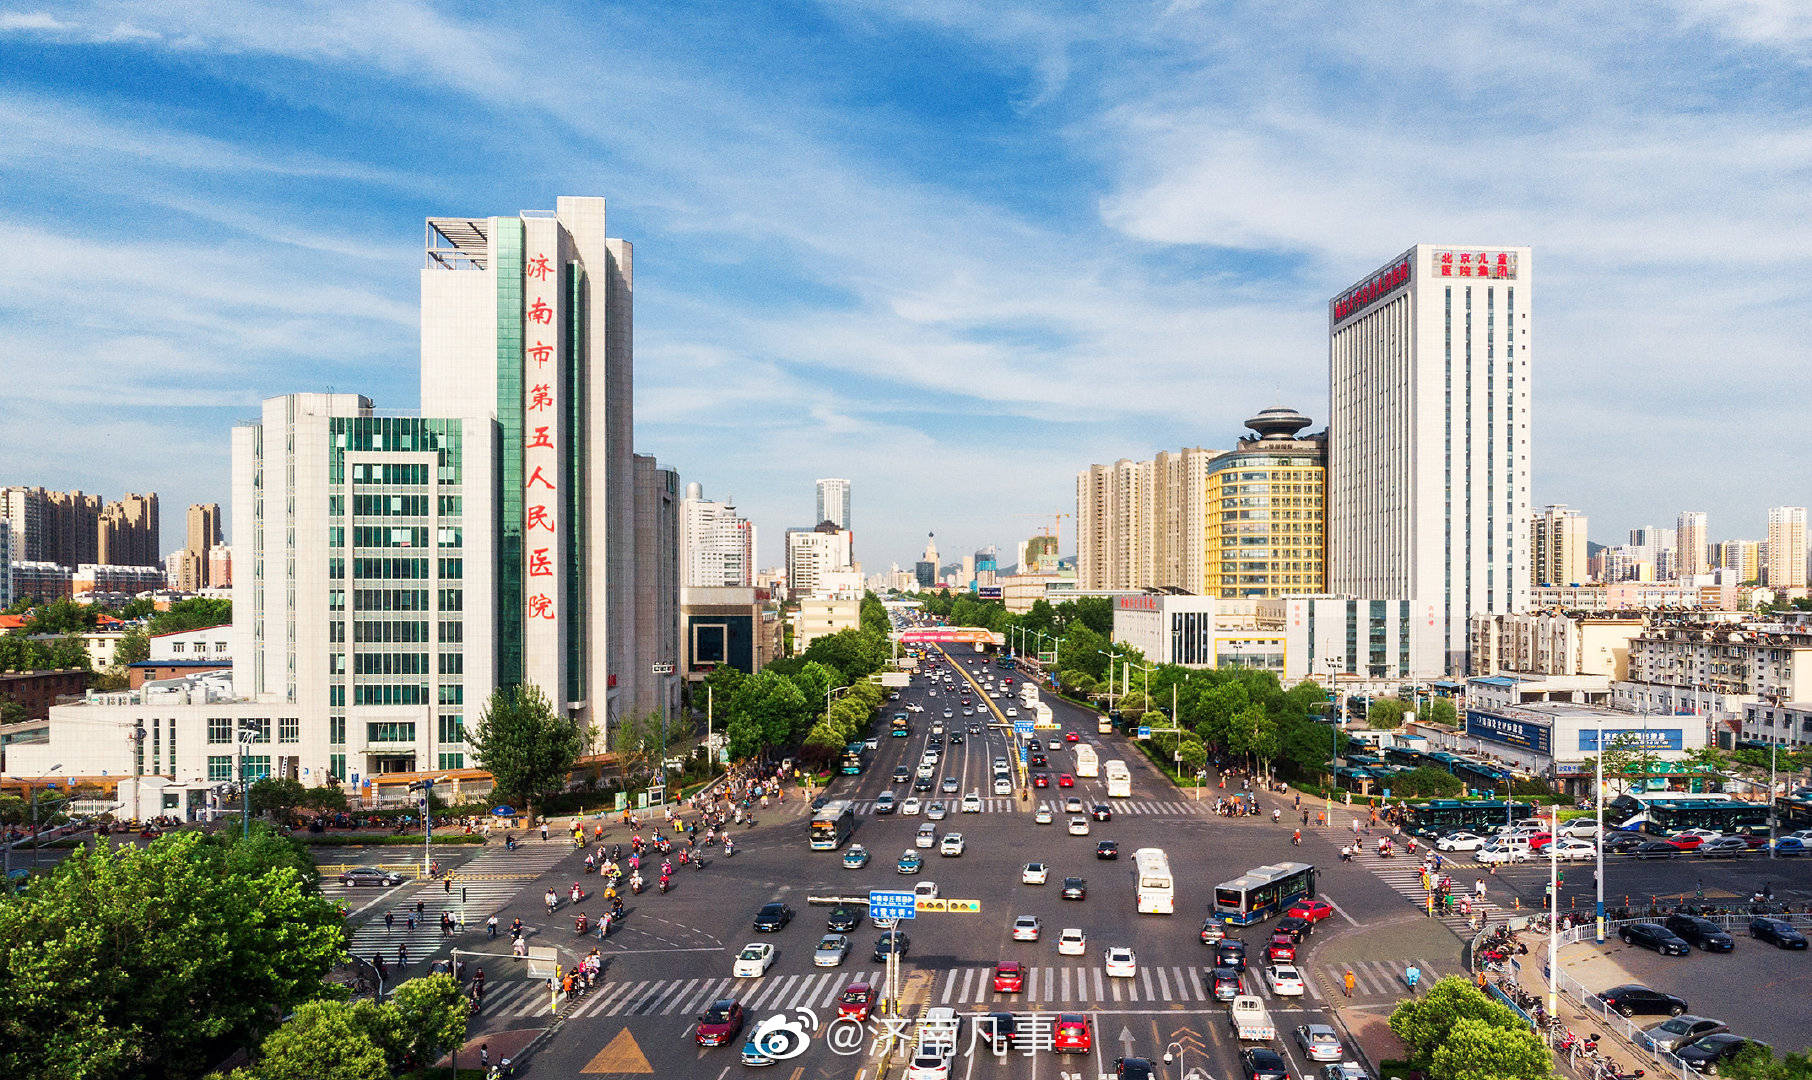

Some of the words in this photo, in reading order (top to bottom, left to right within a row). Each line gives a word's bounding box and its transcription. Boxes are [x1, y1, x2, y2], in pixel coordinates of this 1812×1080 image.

[1441, 252, 1508, 265] 北京儿童
[1441, 264, 1508, 277] 医院集团
[526, 253, 557, 620] 济南市第五人民医院
